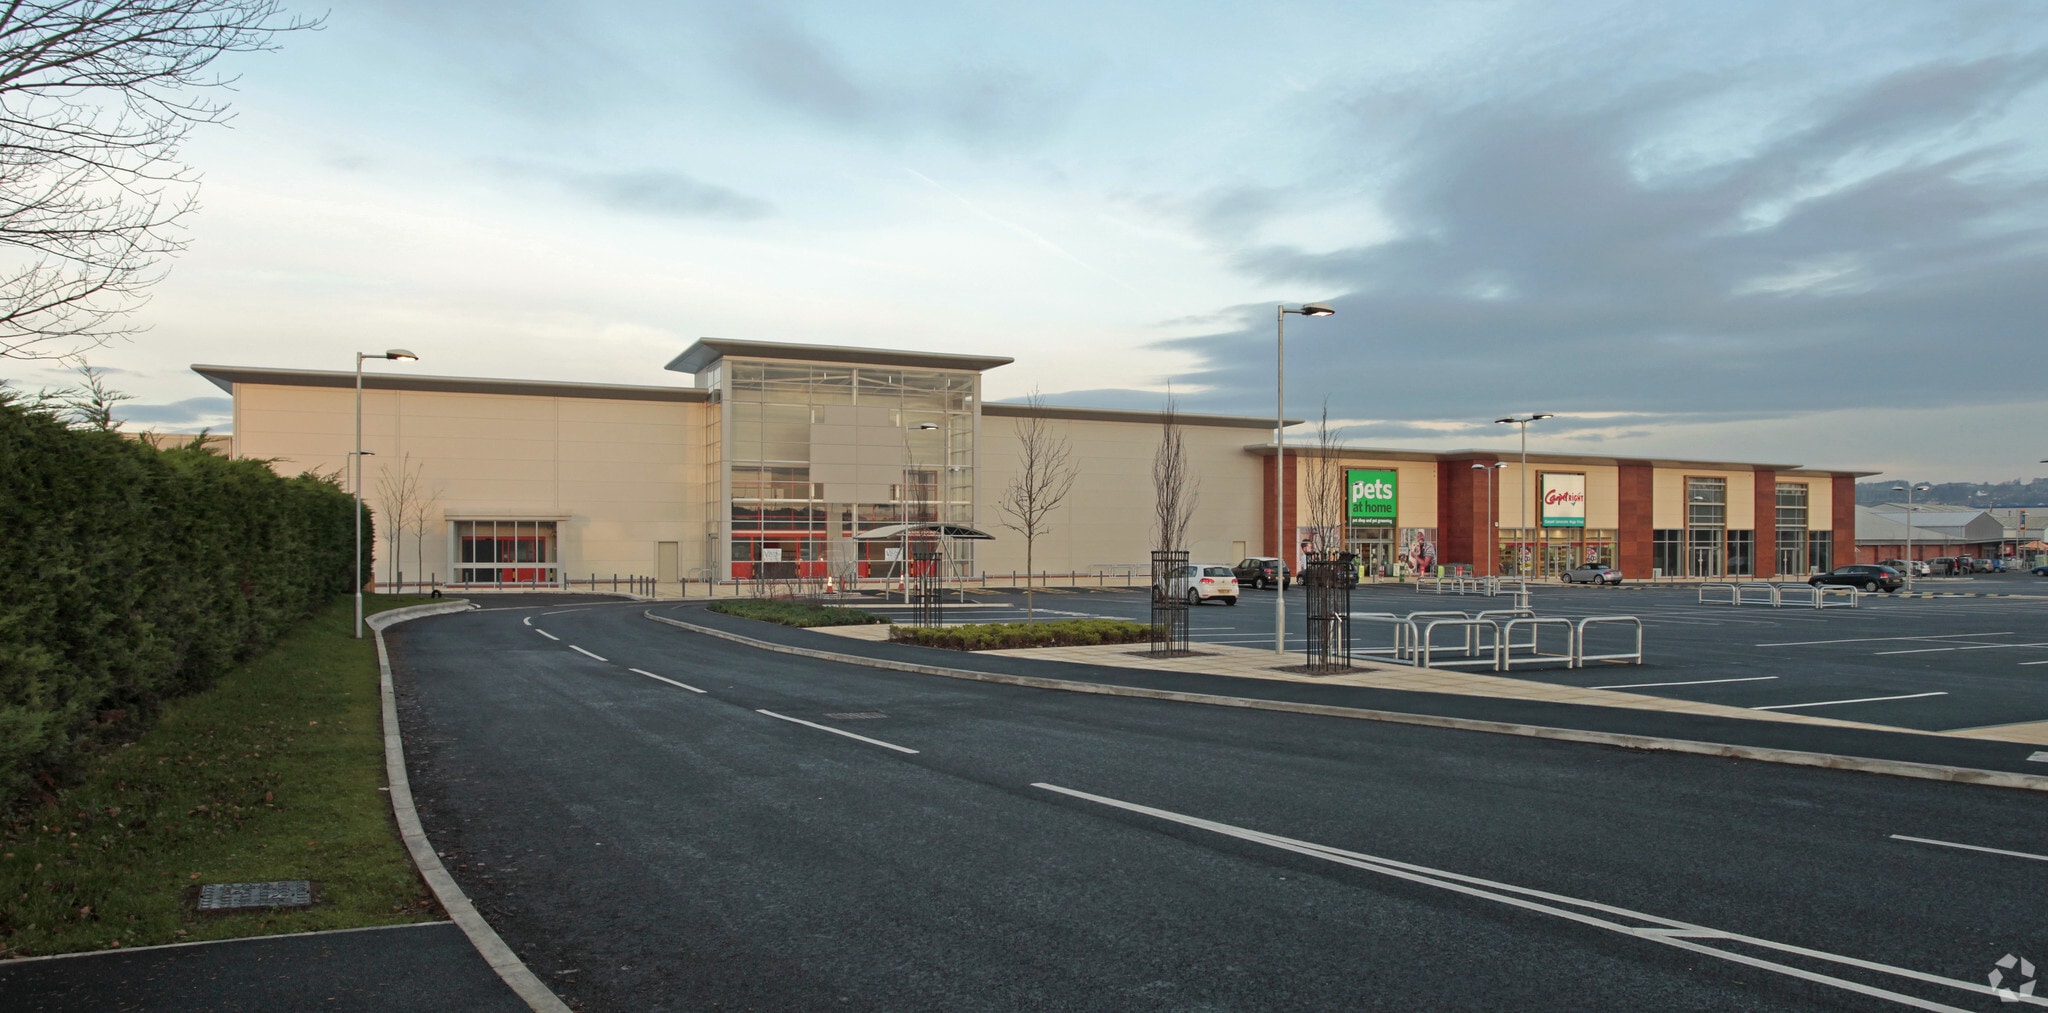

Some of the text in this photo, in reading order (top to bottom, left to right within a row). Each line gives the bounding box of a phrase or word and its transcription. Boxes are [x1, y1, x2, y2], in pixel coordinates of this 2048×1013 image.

[1353, 479, 1393, 503] pets
[1353, 501, 1392, 513] at home
